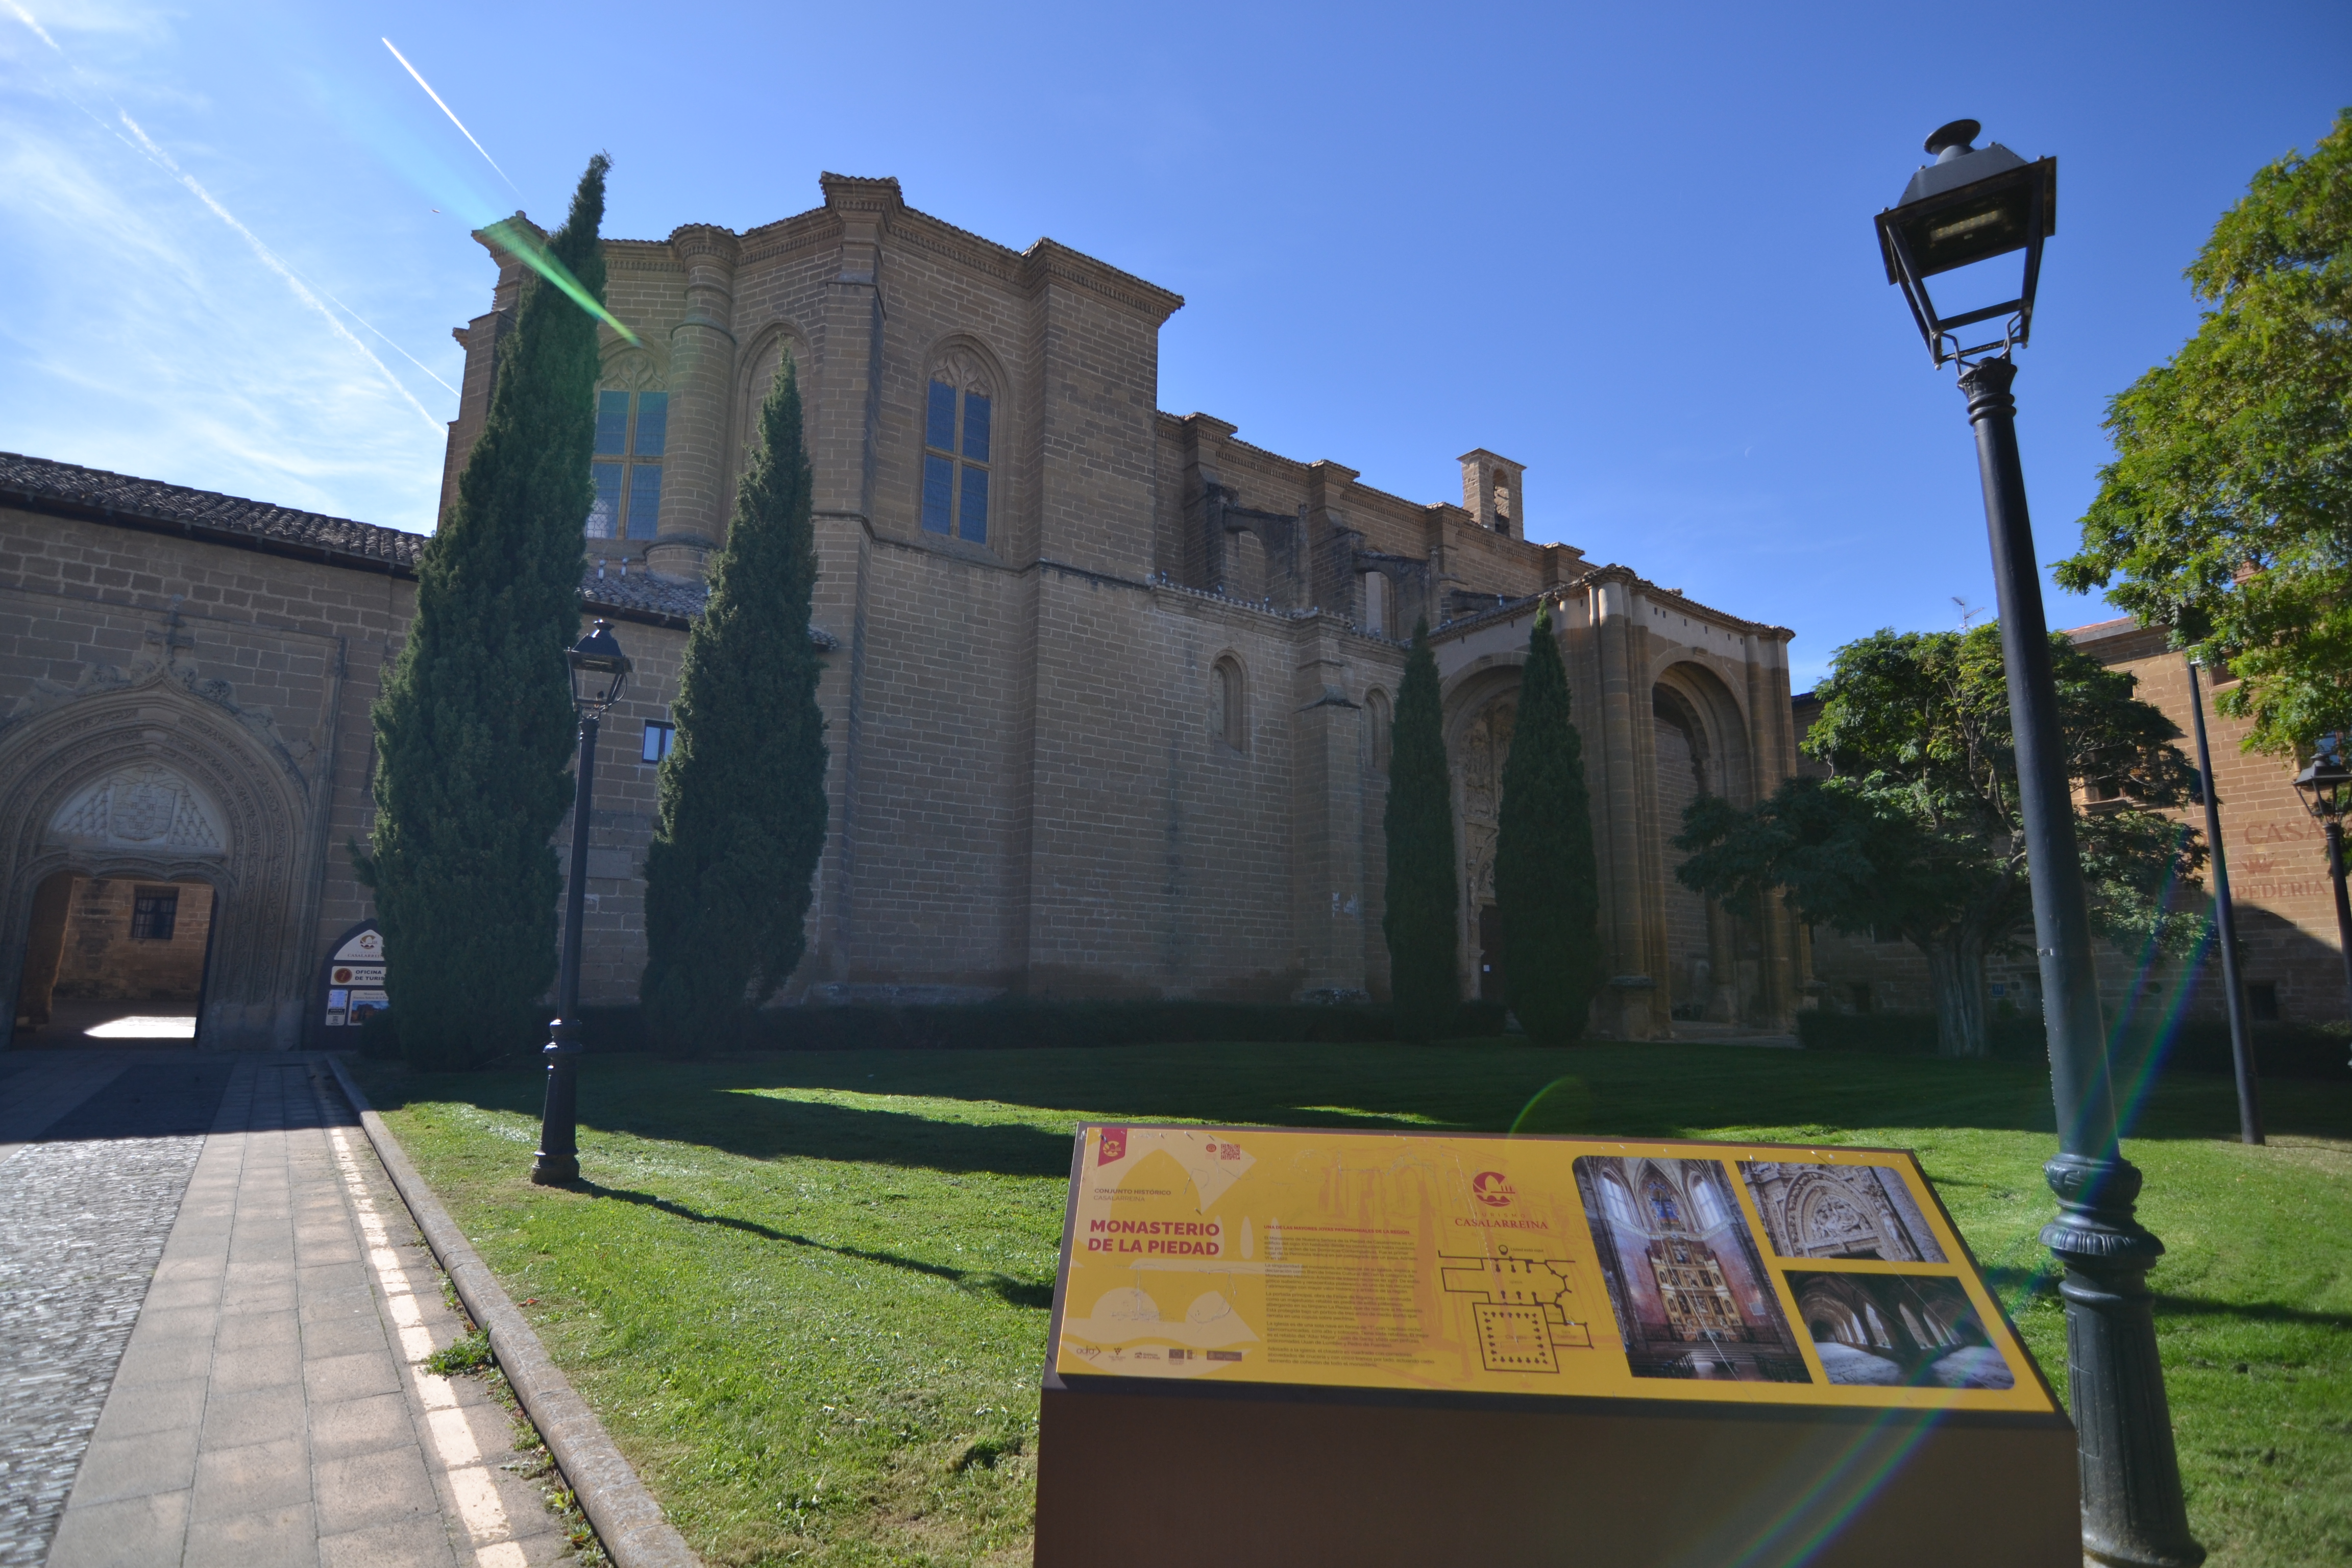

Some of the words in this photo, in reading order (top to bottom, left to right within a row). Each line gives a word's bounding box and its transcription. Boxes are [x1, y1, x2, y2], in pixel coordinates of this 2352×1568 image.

[1090, 1219, 1220, 1236] MONASTERIO
[1455, 1218, 1549, 1229] CASALARREINA
[1088, 1238, 1113, 1252] DE
[1118, 1239, 1143, 1253] LA
[1147, 1240, 1219, 1256] PIEDAD
